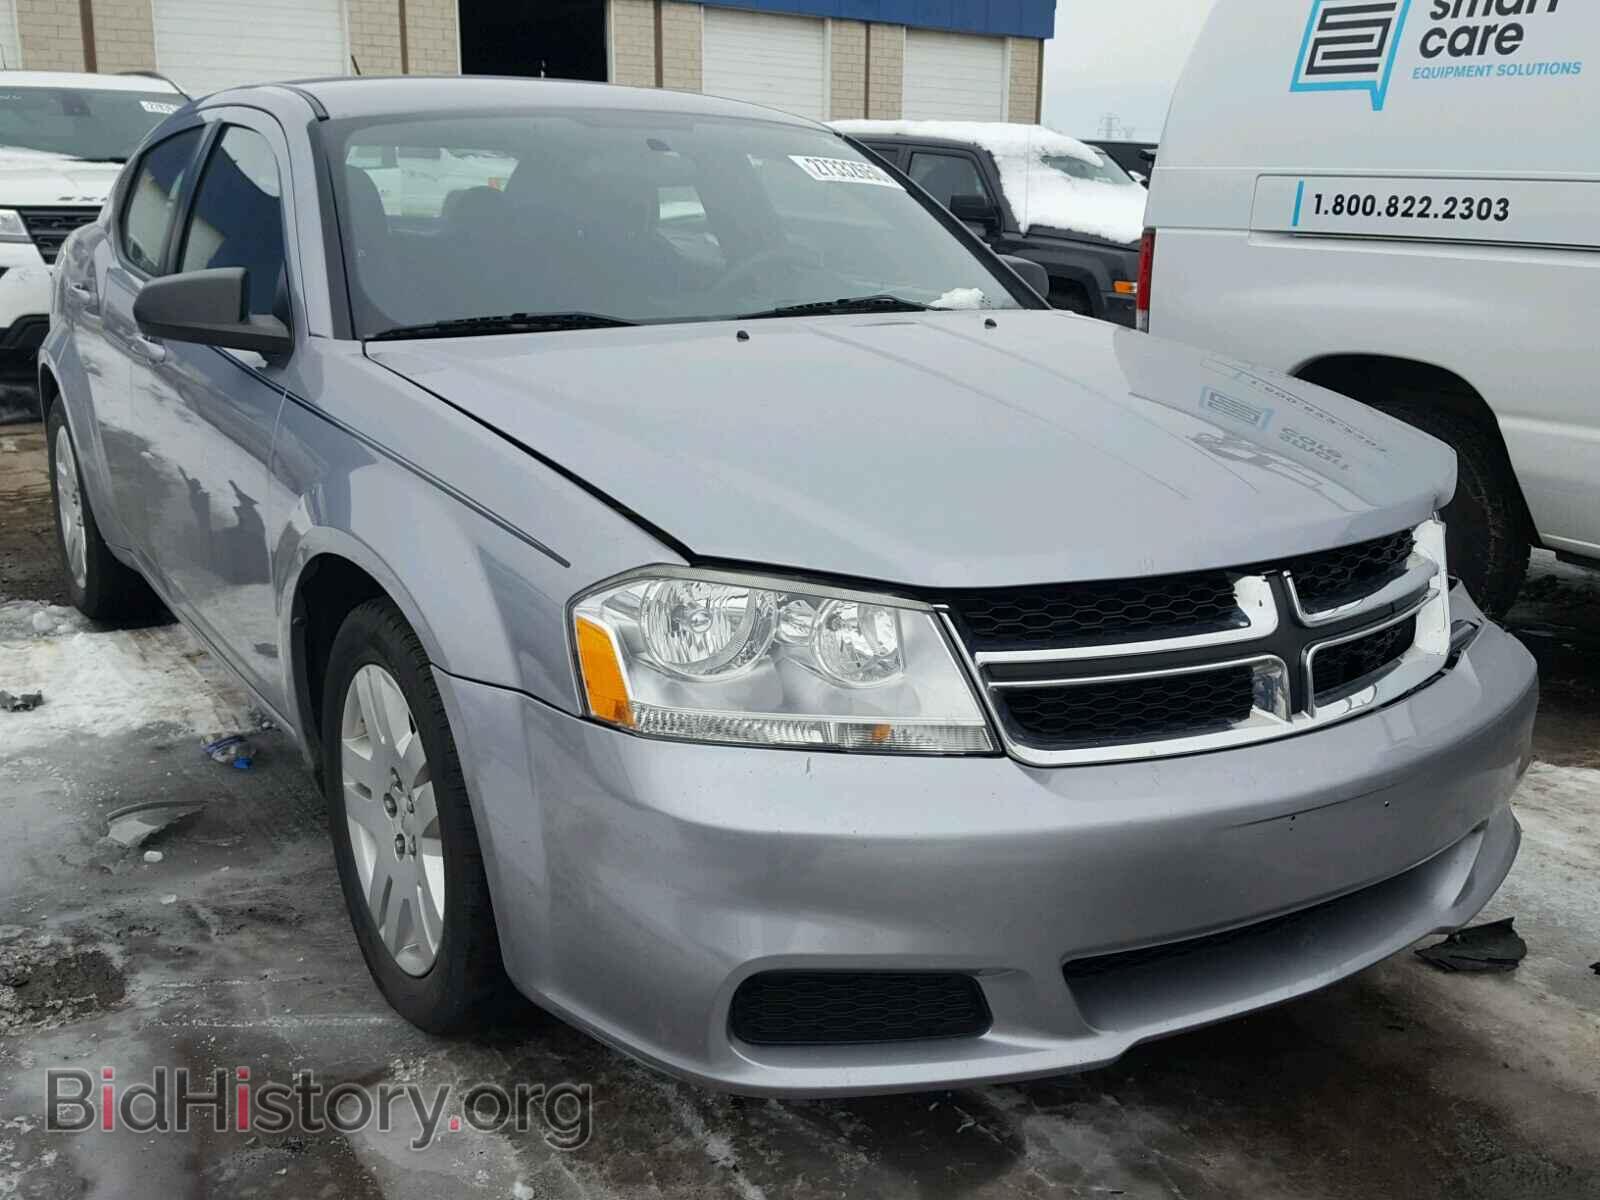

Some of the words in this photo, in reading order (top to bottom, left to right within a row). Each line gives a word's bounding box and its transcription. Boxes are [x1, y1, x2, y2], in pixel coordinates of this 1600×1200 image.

[1419, 22, 1524, 58] care
[1412, 64, 1493, 80] EQUIPMENT
[1496, 61, 1582, 77] SOLUTIONS
[1313, 193, 1510, 222] 1.800.822.2303
